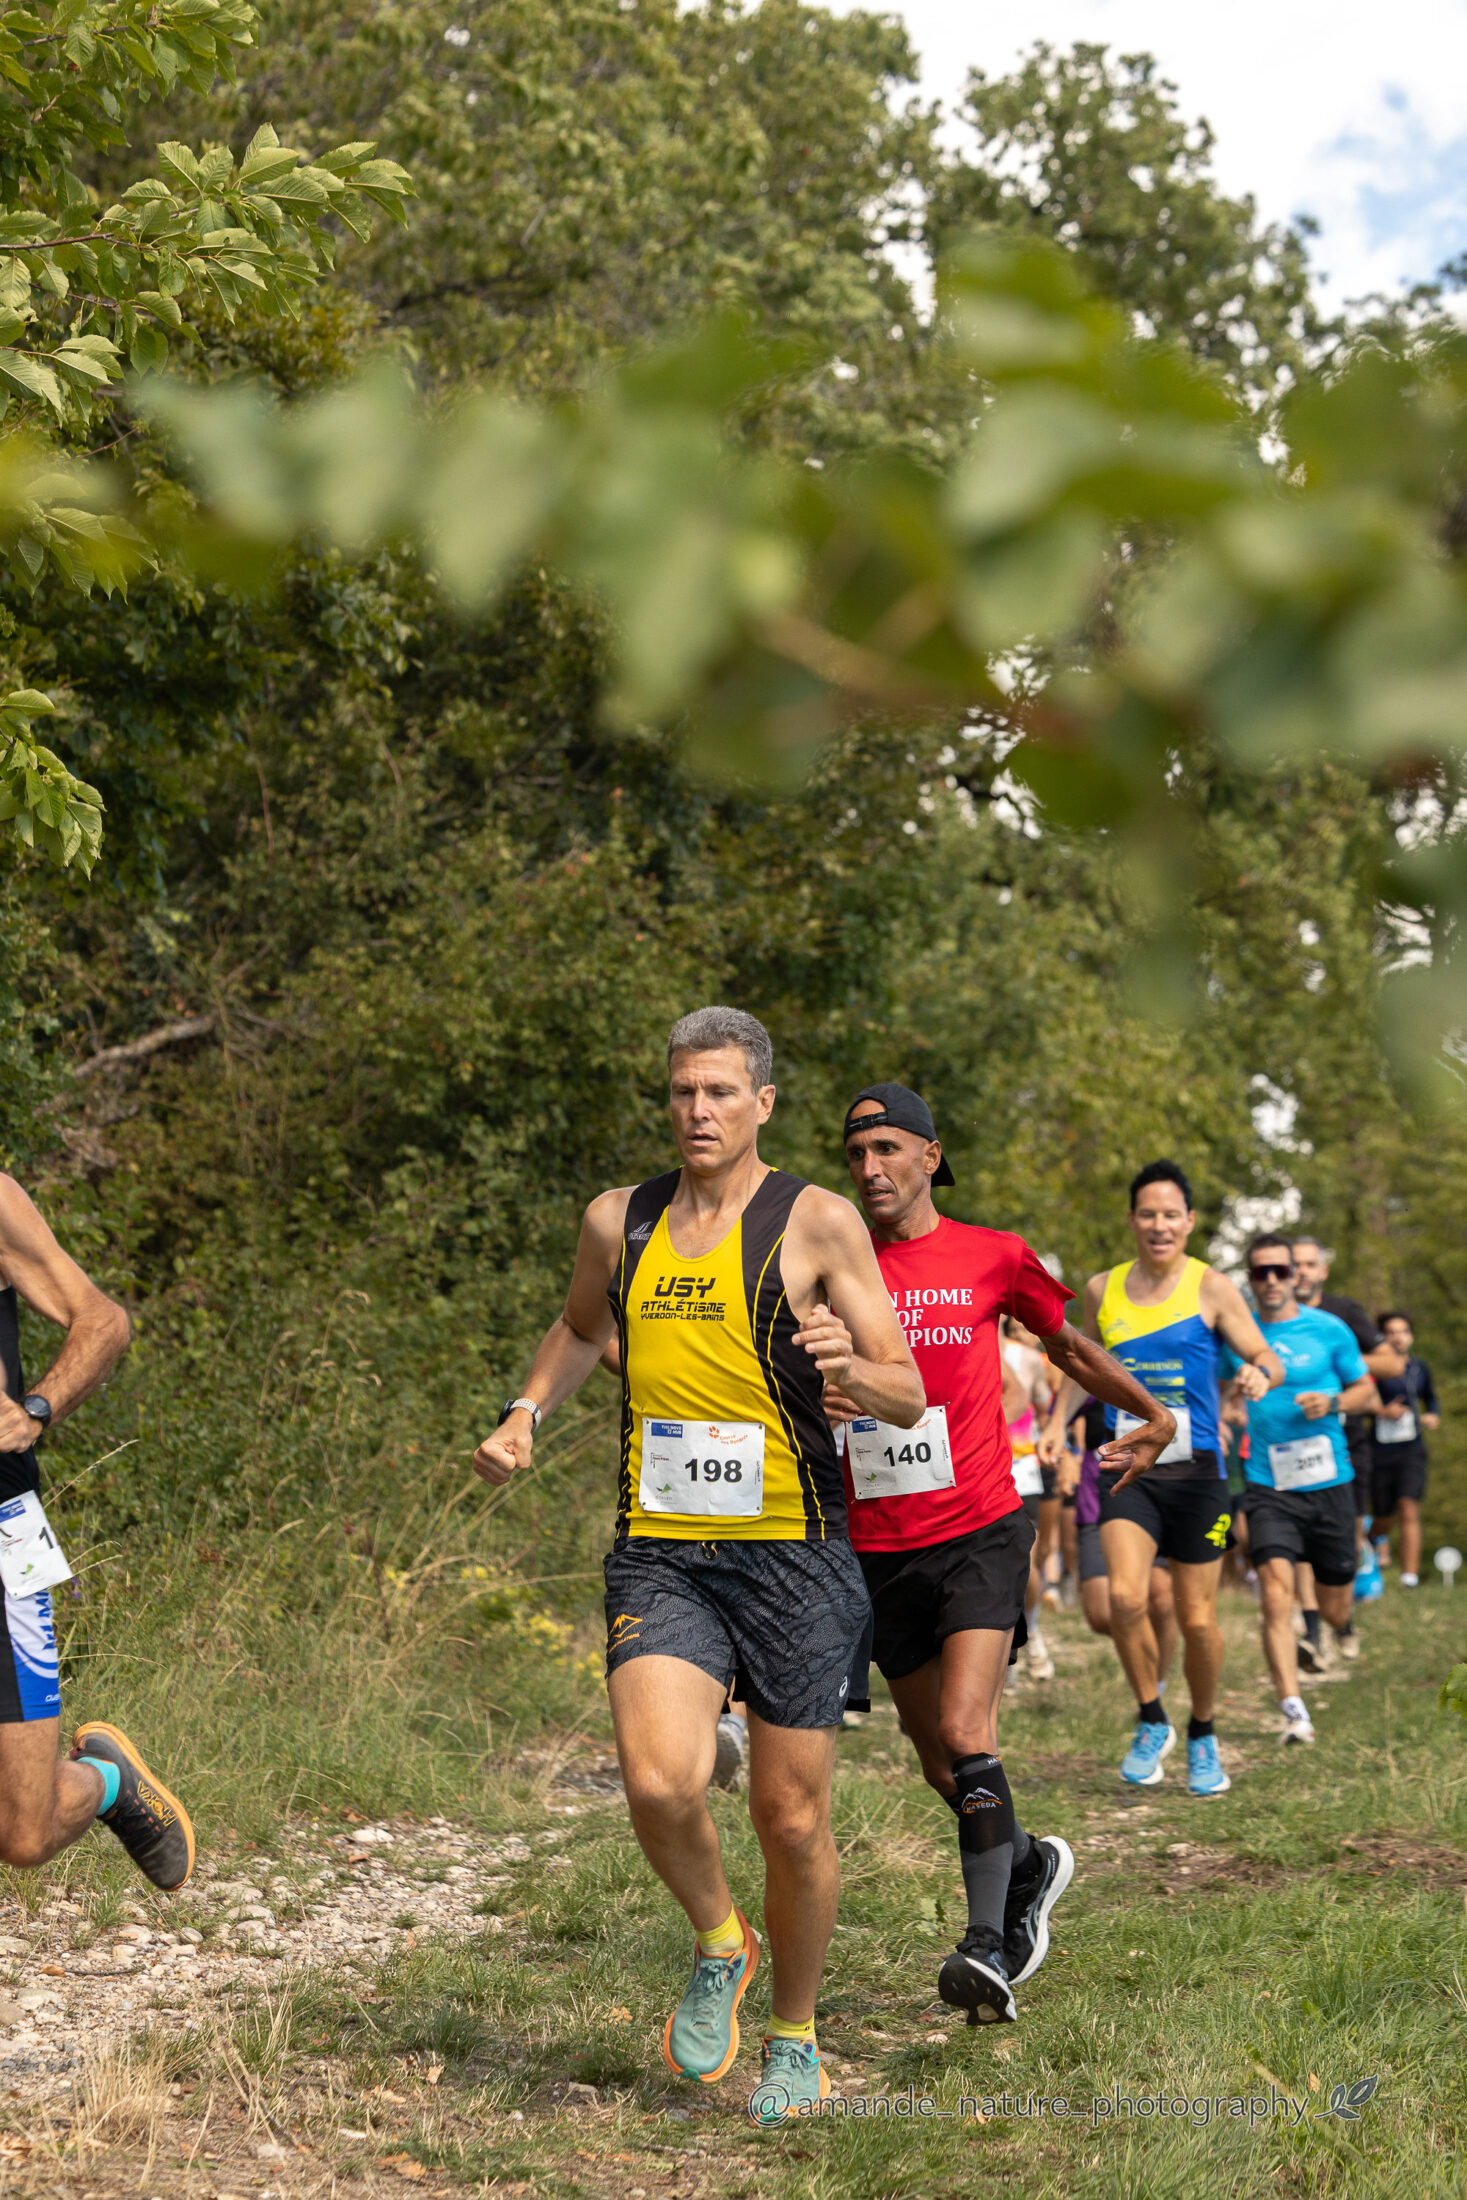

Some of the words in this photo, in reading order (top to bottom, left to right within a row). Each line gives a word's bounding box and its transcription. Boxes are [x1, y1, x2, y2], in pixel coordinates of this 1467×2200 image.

[654, 1276, 717, 1298] USY
[904, 1288, 973, 1308] HOME
[640, 1312, 725, 1322] YVERDON-LES-BAINS
[896, 1308, 924, 1328] OF
[883, 1442, 932, 1467] 140
[684, 1458, 743, 1483] 198
[137, 1780, 178, 1827] HOKA
